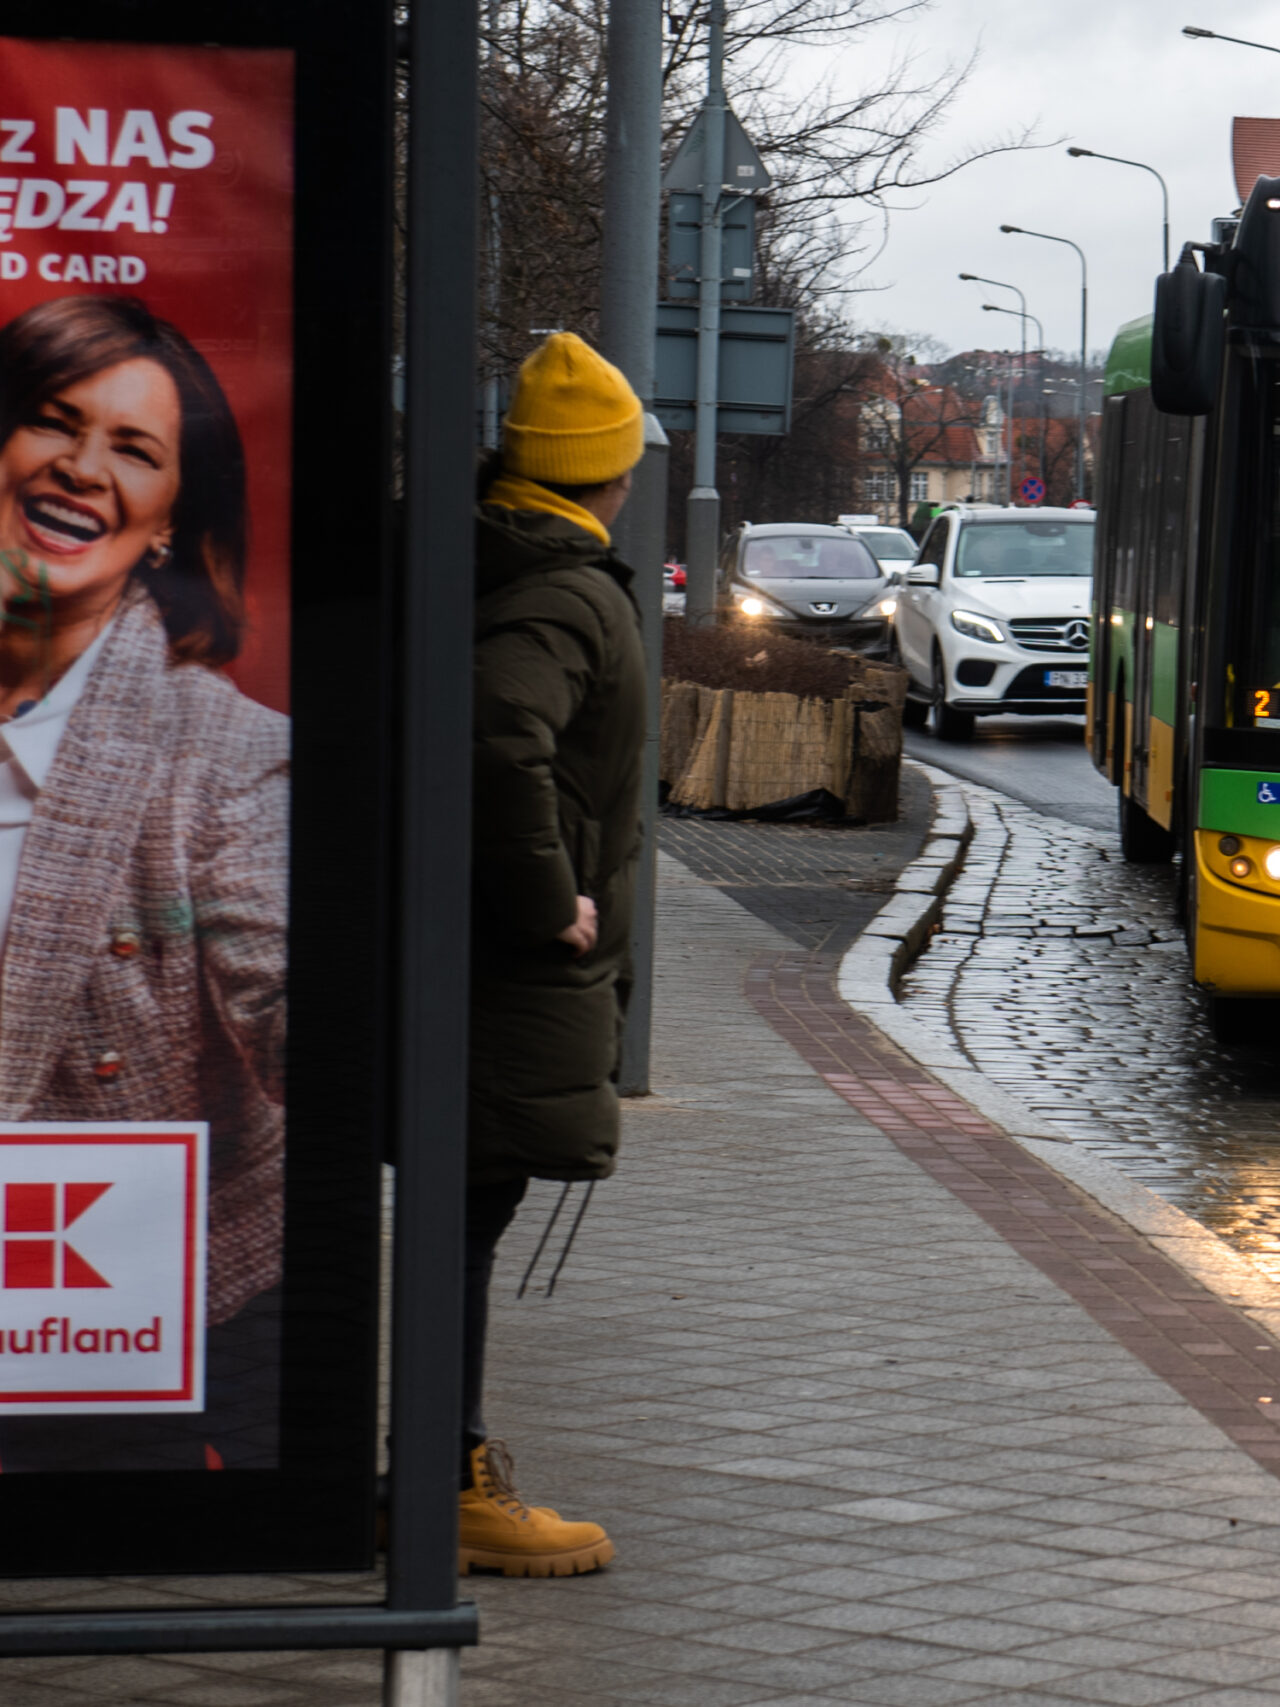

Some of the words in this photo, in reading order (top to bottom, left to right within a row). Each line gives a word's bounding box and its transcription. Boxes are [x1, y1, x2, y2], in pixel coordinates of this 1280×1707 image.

[55, 106, 215, 169] NAS
[37, 253, 147, 285] CARD
[1253, 689, 1271, 717] 2
[0, 1316, 163, 1354] ufland
